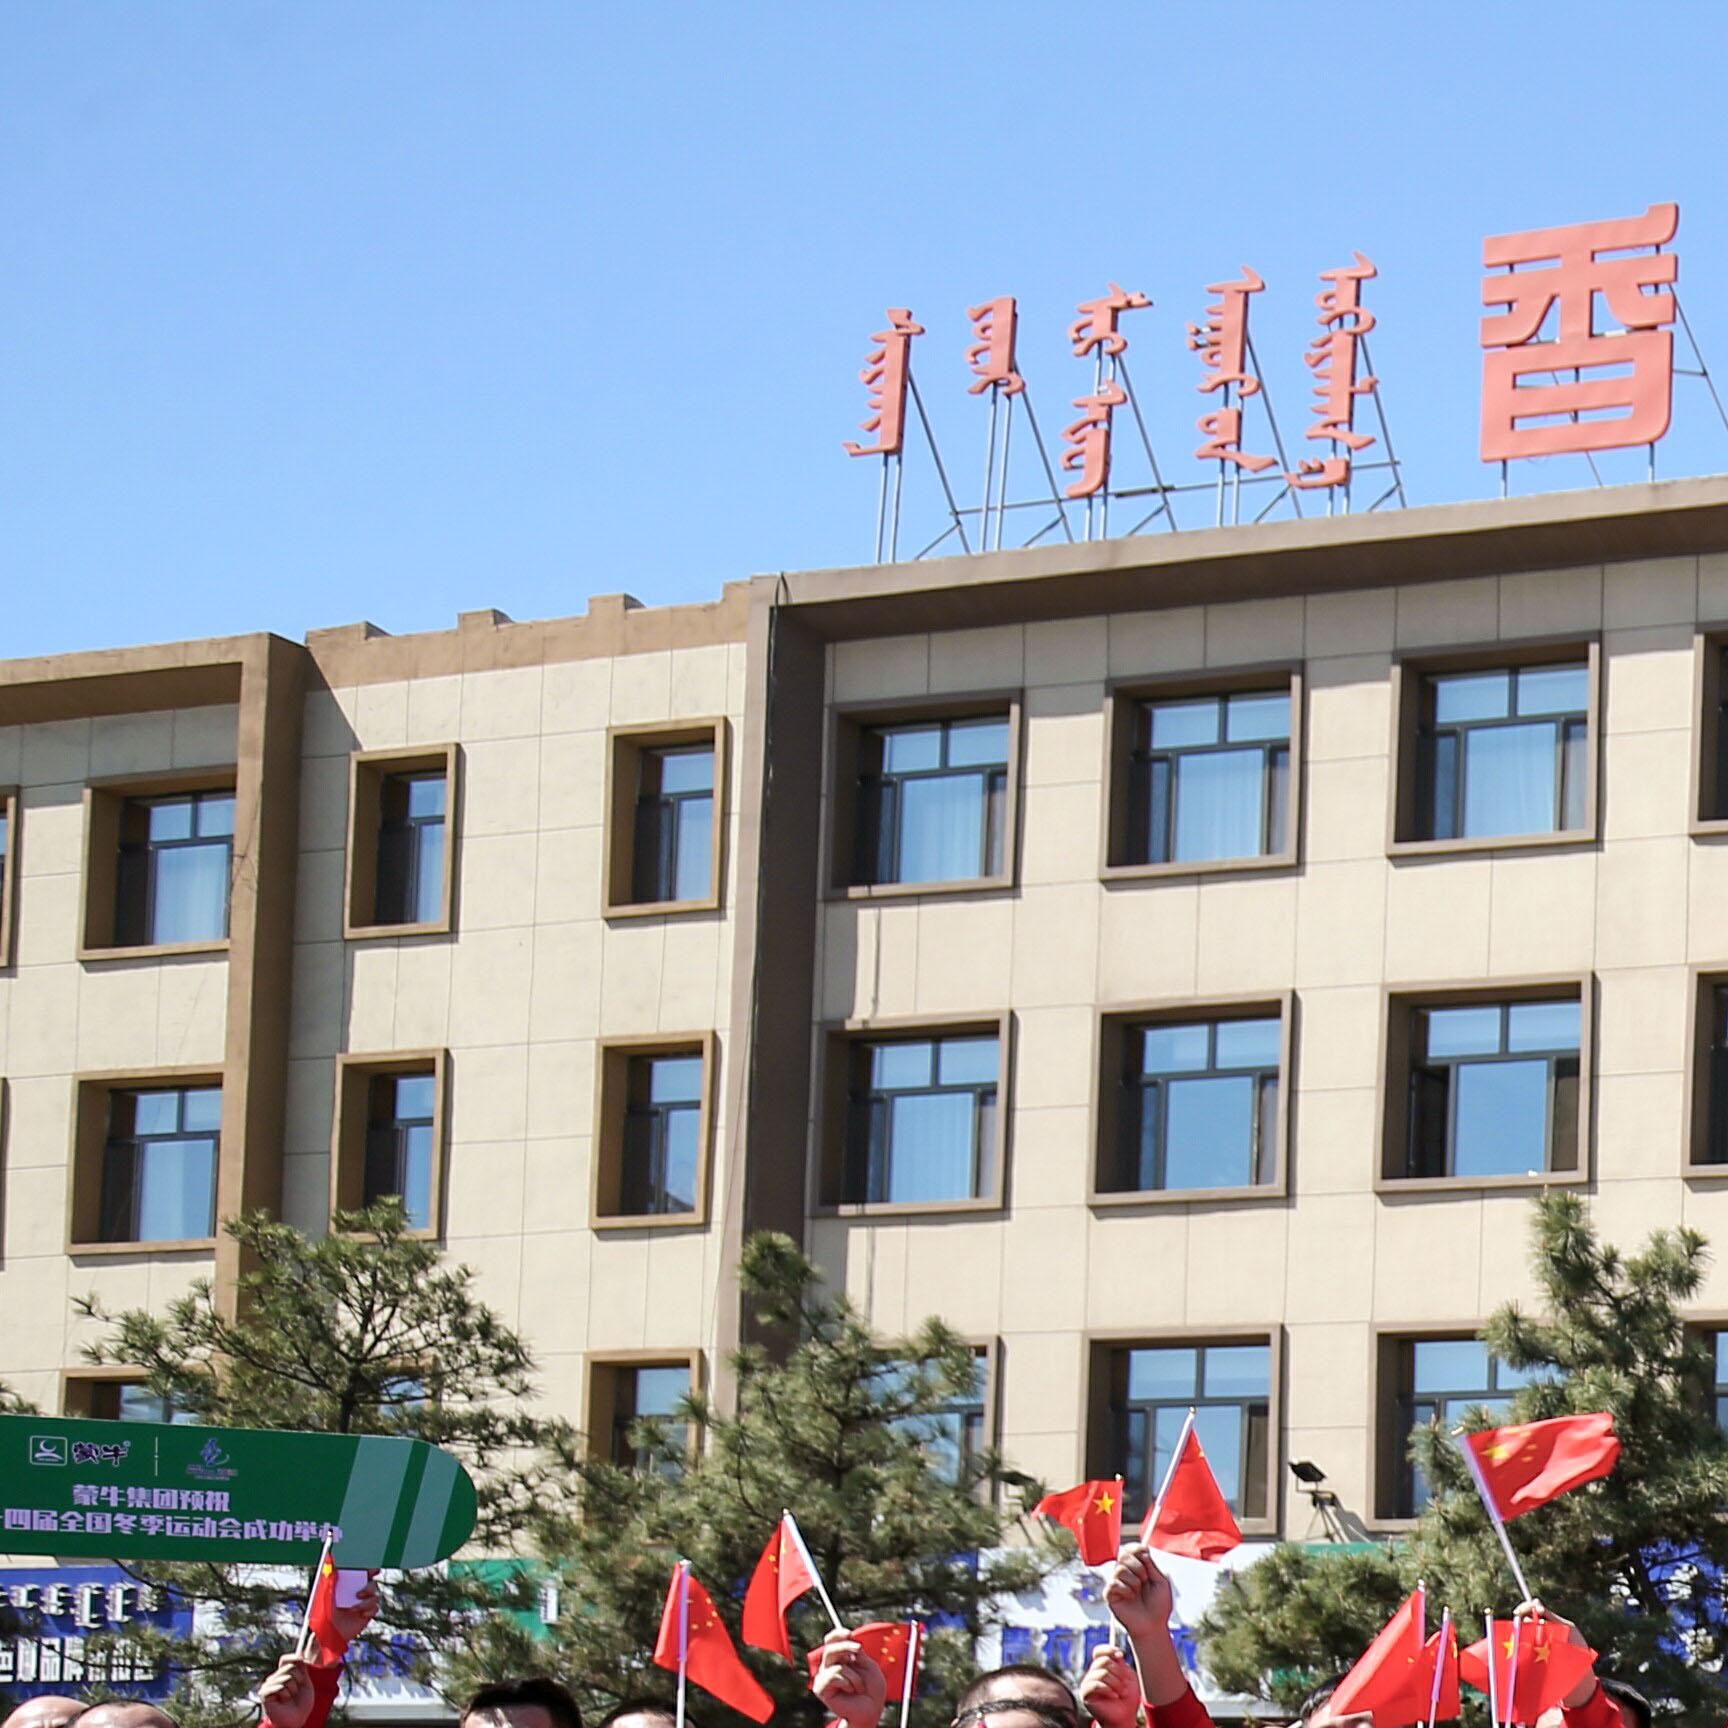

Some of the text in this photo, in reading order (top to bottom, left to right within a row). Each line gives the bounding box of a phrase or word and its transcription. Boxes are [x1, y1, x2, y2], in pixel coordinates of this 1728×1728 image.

[72, 1483, 231, 1513] 蒙牛集团预祝
[0, 1507, 344, 1544] 四届全国冬季运动会成功举办
